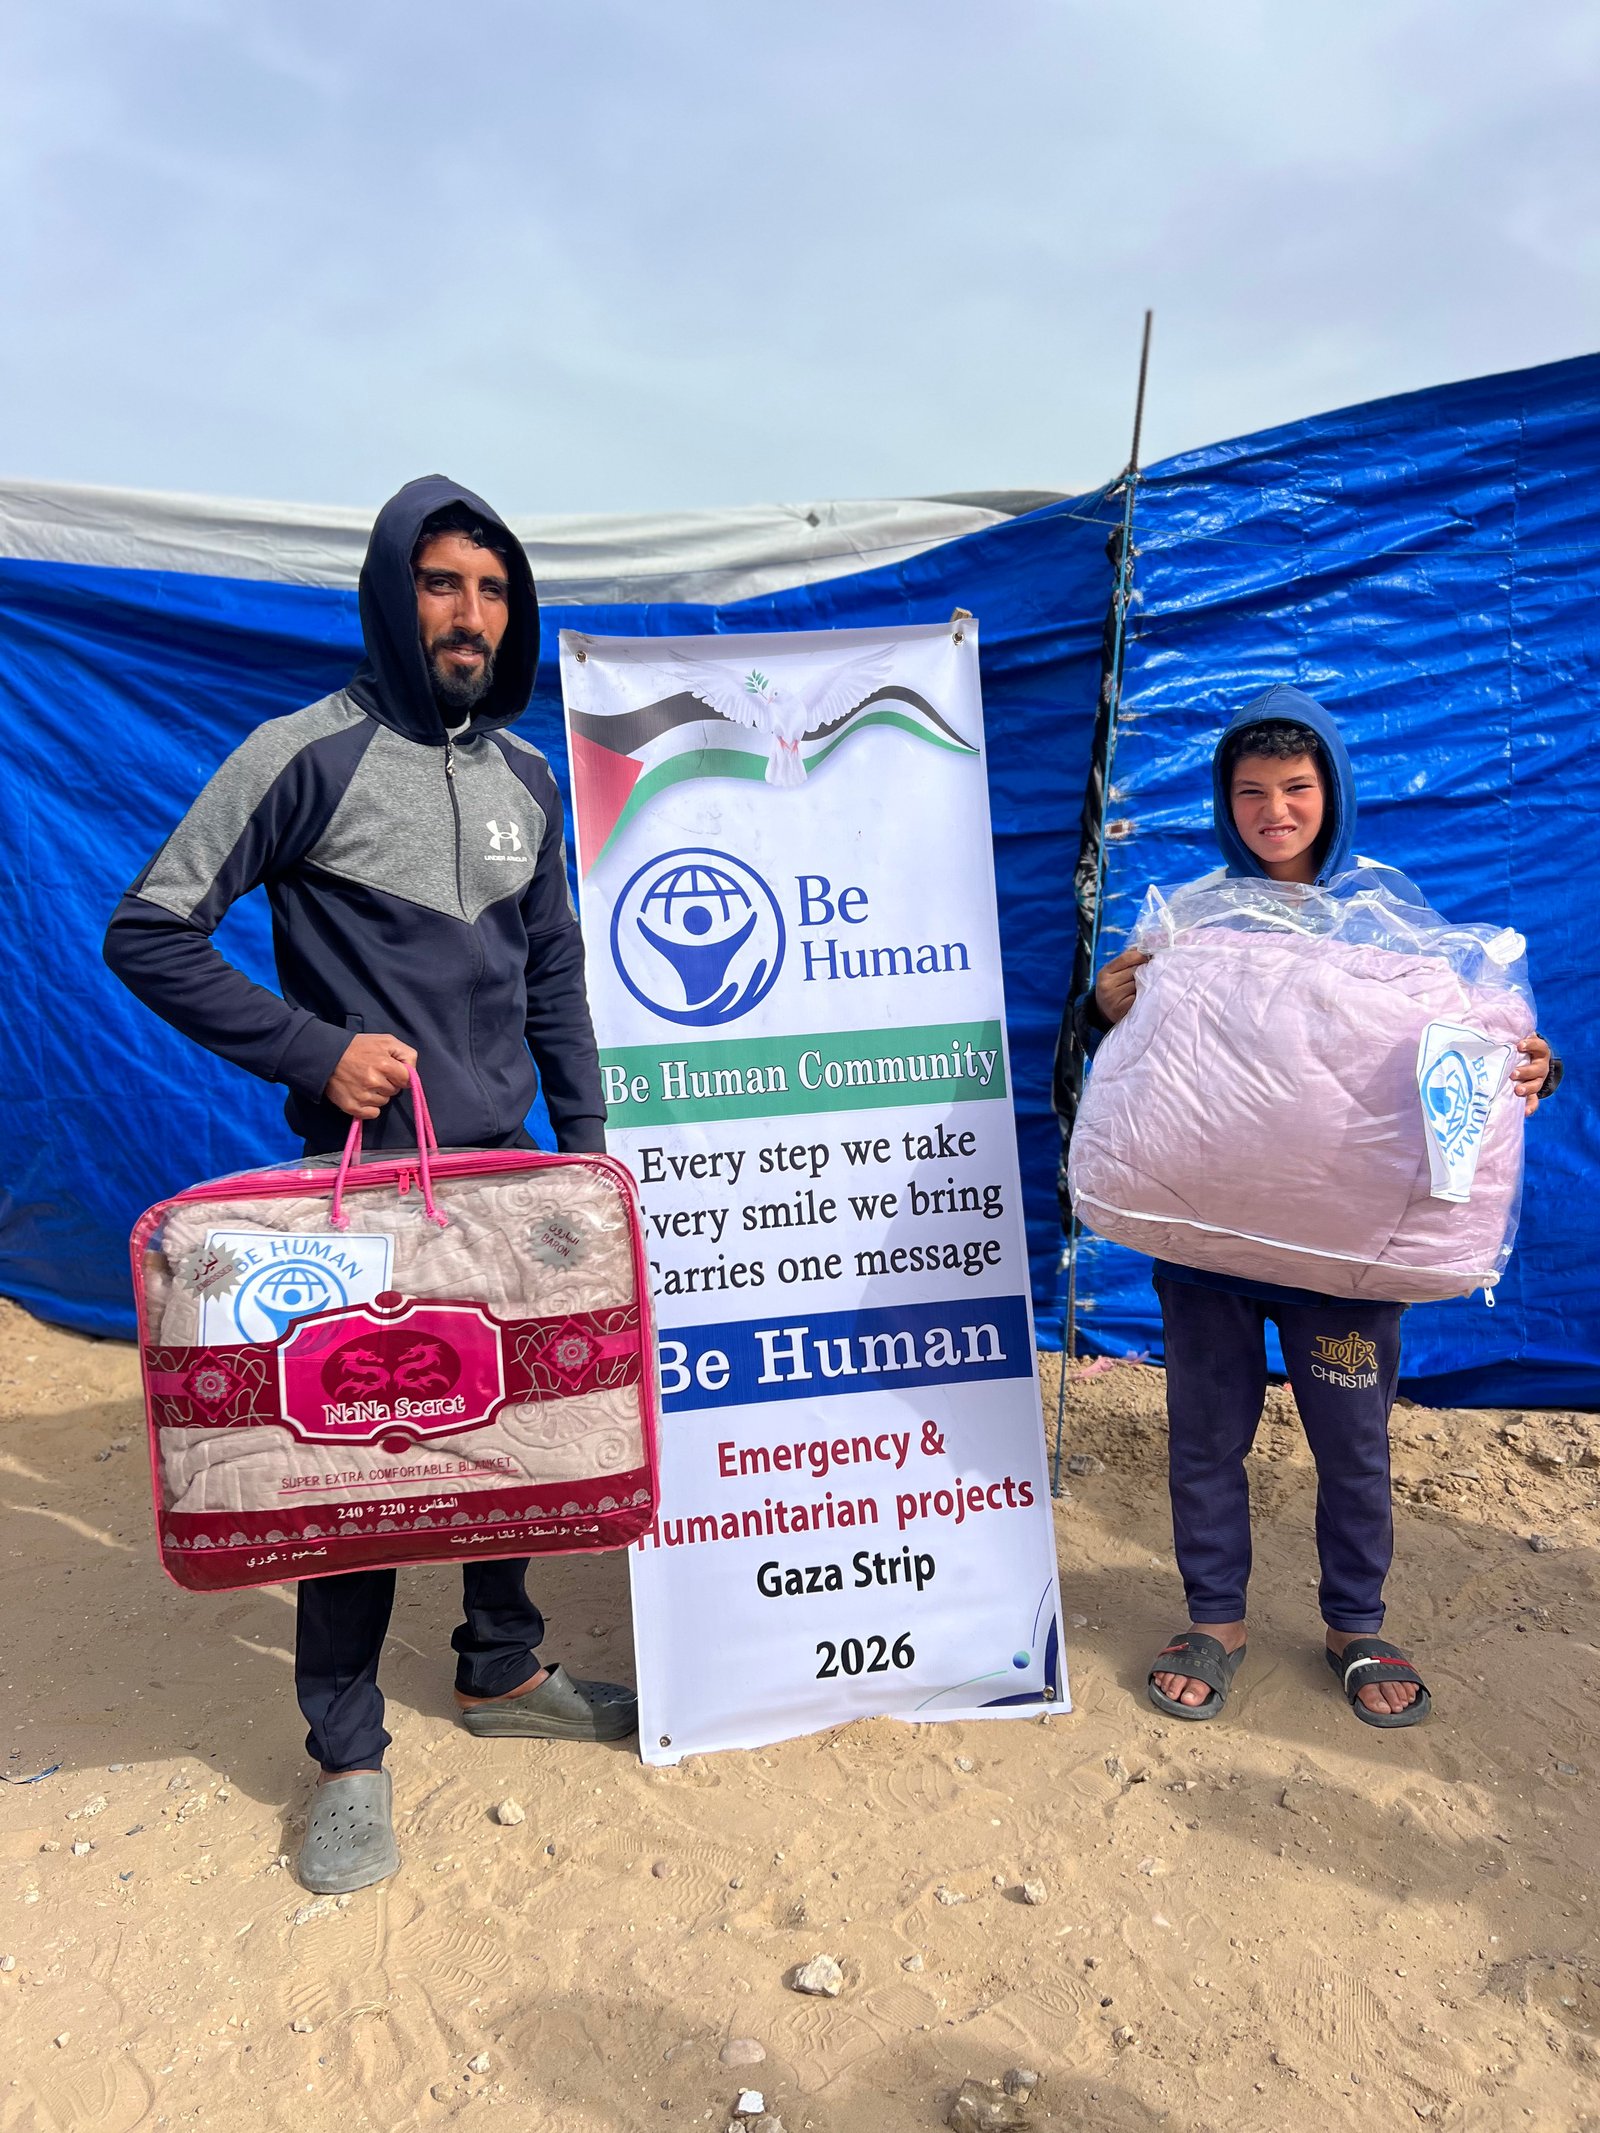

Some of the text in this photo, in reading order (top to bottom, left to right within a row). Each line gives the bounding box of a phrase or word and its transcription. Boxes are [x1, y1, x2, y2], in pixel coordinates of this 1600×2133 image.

[794, 875, 869, 926] Be
[800, 939, 971, 981] Human
[601, 1039, 998, 1106] Be Human Community
[1472, 1056, 1489, 1084] BE
[638, 1124, 977, 1184] Every step we take
[641, 1178, 1004, 1244] very smile we bring
[270, 1239, 364, 1280] HUMAN
[541, 1232, 571, 1257] BARON
[777, 1252, 843, 1284] one
[855, 1238, 1002, 1277] message
[658, 1320, 1007, 1395] Be Human
[1311, 1364, 1378, 1388] CHRISTIAN
[321, 1394, 466, 1426] NaNa Secret
[717, 1419, 946, 1477] Emergency &
[281, 1456, 512, 1489] SUPER EXTRA COMFORTABLE BLANKET
[337, 1507, 364, 1519] 240
[379, 1503, 405, 1516] 220
[418, 1497, 459, 1514] المقاس
[638, 1476, 1034, 1552] Humanitarian projects
[757, 1545, 936, 1597] Gaza Strip
[815, 1631, 916, 1679] 2026
